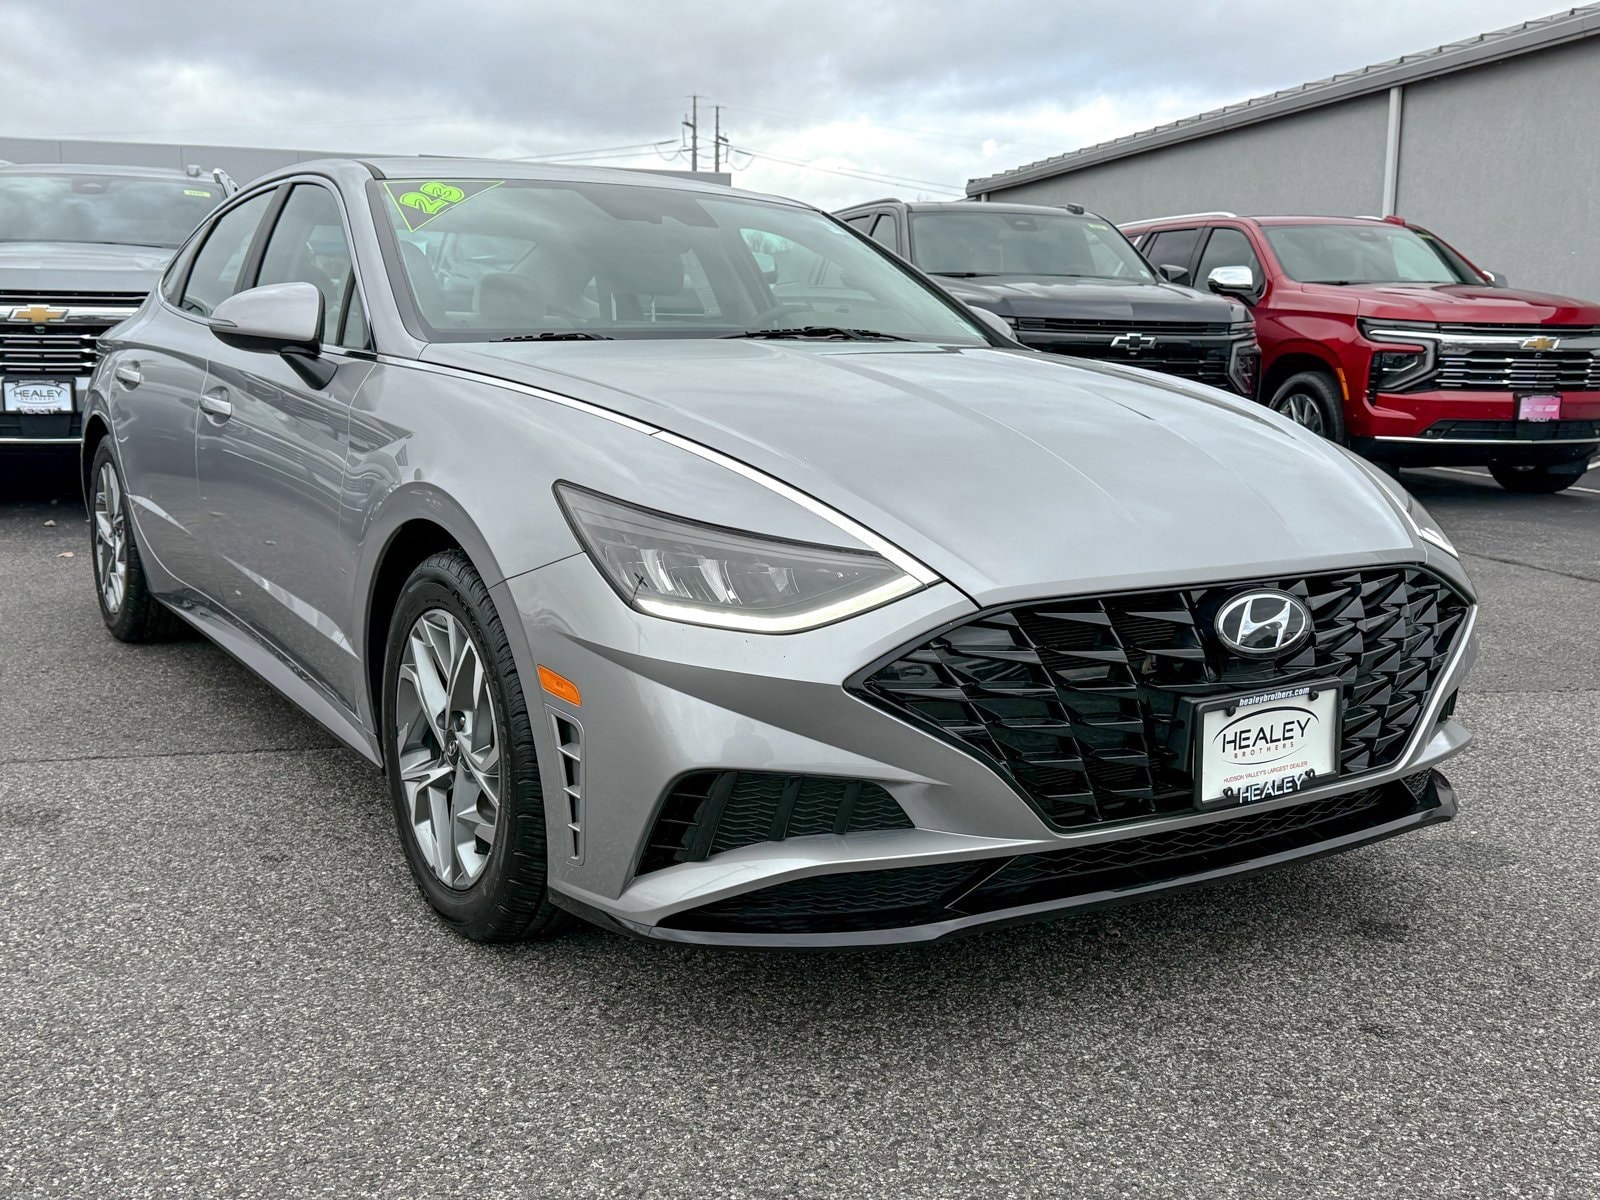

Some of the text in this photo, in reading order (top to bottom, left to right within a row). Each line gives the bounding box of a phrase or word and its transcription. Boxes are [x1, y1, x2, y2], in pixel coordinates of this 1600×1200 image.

[400, 182, 465, 214] 23
[13, 390, 63, 398] HEALEY
[1239, 687, 1310, 707] healeybrothers.com
[1222, 717, 1311, 753] HEALEY
[1234, 741, 1294, 759] BROTHERS
[1223, 760, 1308, 783] HUDSON VALLEY'S LARGEST DEALER
[1239, 774, 1304, 804] HEALEY
